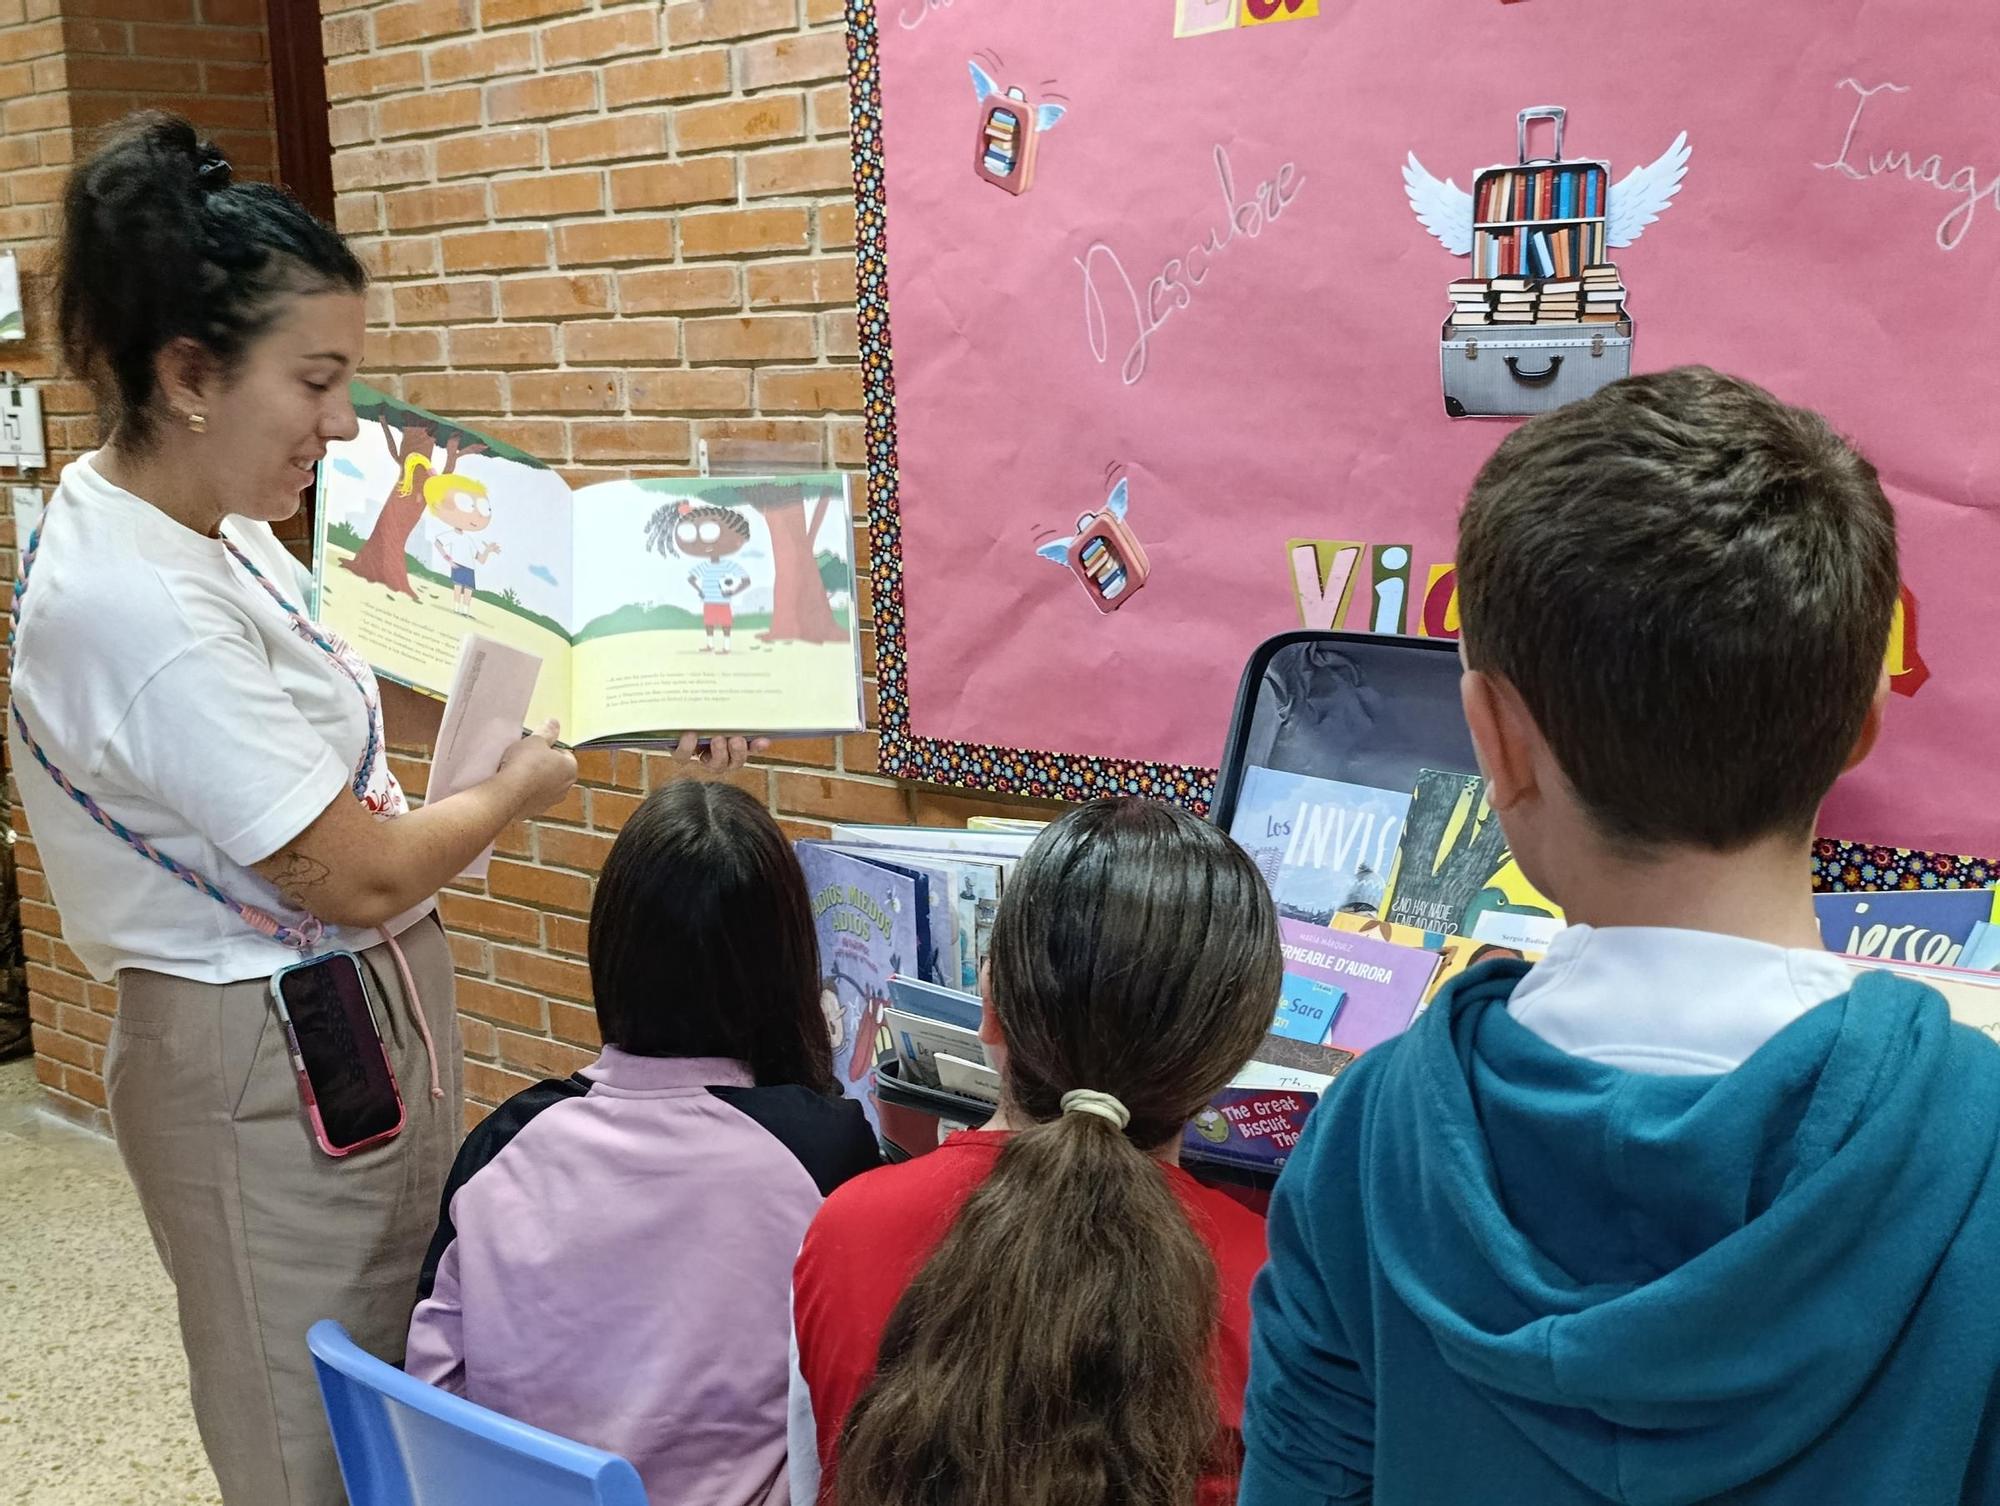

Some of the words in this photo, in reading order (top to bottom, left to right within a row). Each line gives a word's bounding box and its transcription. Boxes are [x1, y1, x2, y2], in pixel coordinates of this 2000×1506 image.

[1074, 143, 1306, 385] Descubre
[1267, 815, 1291, 838] Los
[1411, 899, 1430, 917] HAY
[1428, 901, 1455, 922] NADIE
[1334, 958, 1393, 985] D'AURORA
[1288, 998, 1324, 1020] Sara
[1221, 1104, 1251, 1121] The
[1253, 1095, 1300, 1116] Great
[1238, 1115, 1292, 1139] Biscuit
[1271, 1130, 1302, 1148] The
